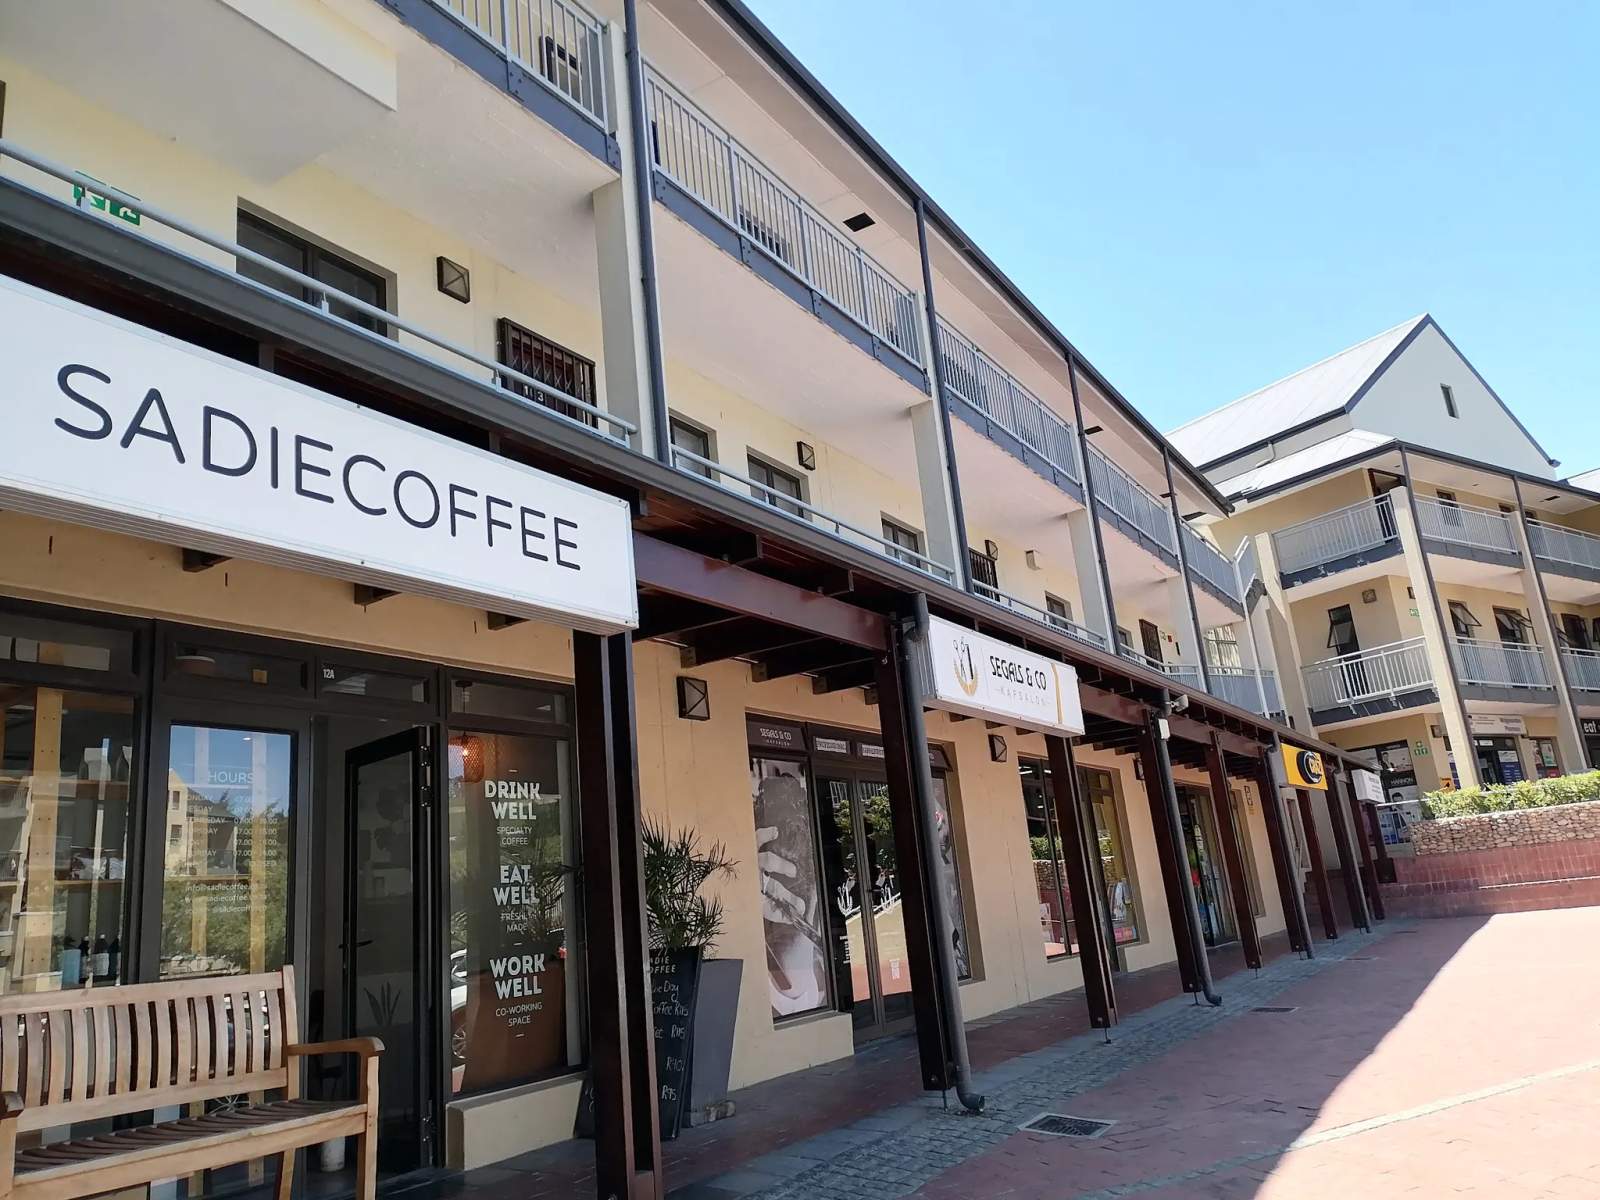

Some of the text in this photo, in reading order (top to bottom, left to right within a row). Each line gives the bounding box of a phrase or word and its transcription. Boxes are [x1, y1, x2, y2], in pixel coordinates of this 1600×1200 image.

[54, 362, 582, 571] SADIECOFFEE
[322, 668, 335, 679] 12A
[989, 655, 1047, 691] SEGALS & CO
[1583, 720, 1597, 733] eat
[208, 771, 255, 784] HOURS
[484, 780, 541, 800] DRINK
[491, 801, 537, 820] WELL
[496, 826, 533, 835] SPECIALTY
[501, 837, 529, 845] COFFEE
[500, 864, 531, 884] EAT
[492, 886, 540, 906] WELL
[489, 953, 546, 978] WORK
[650, 964, 677, 974] OFFEE
[495, 975, 542, 1000] WELL
[495, 1001, 543, 1017] CO-WORKING
[653, 1001, 673, 1015] offee
[508, 1014, 531, 1027] SPACE
